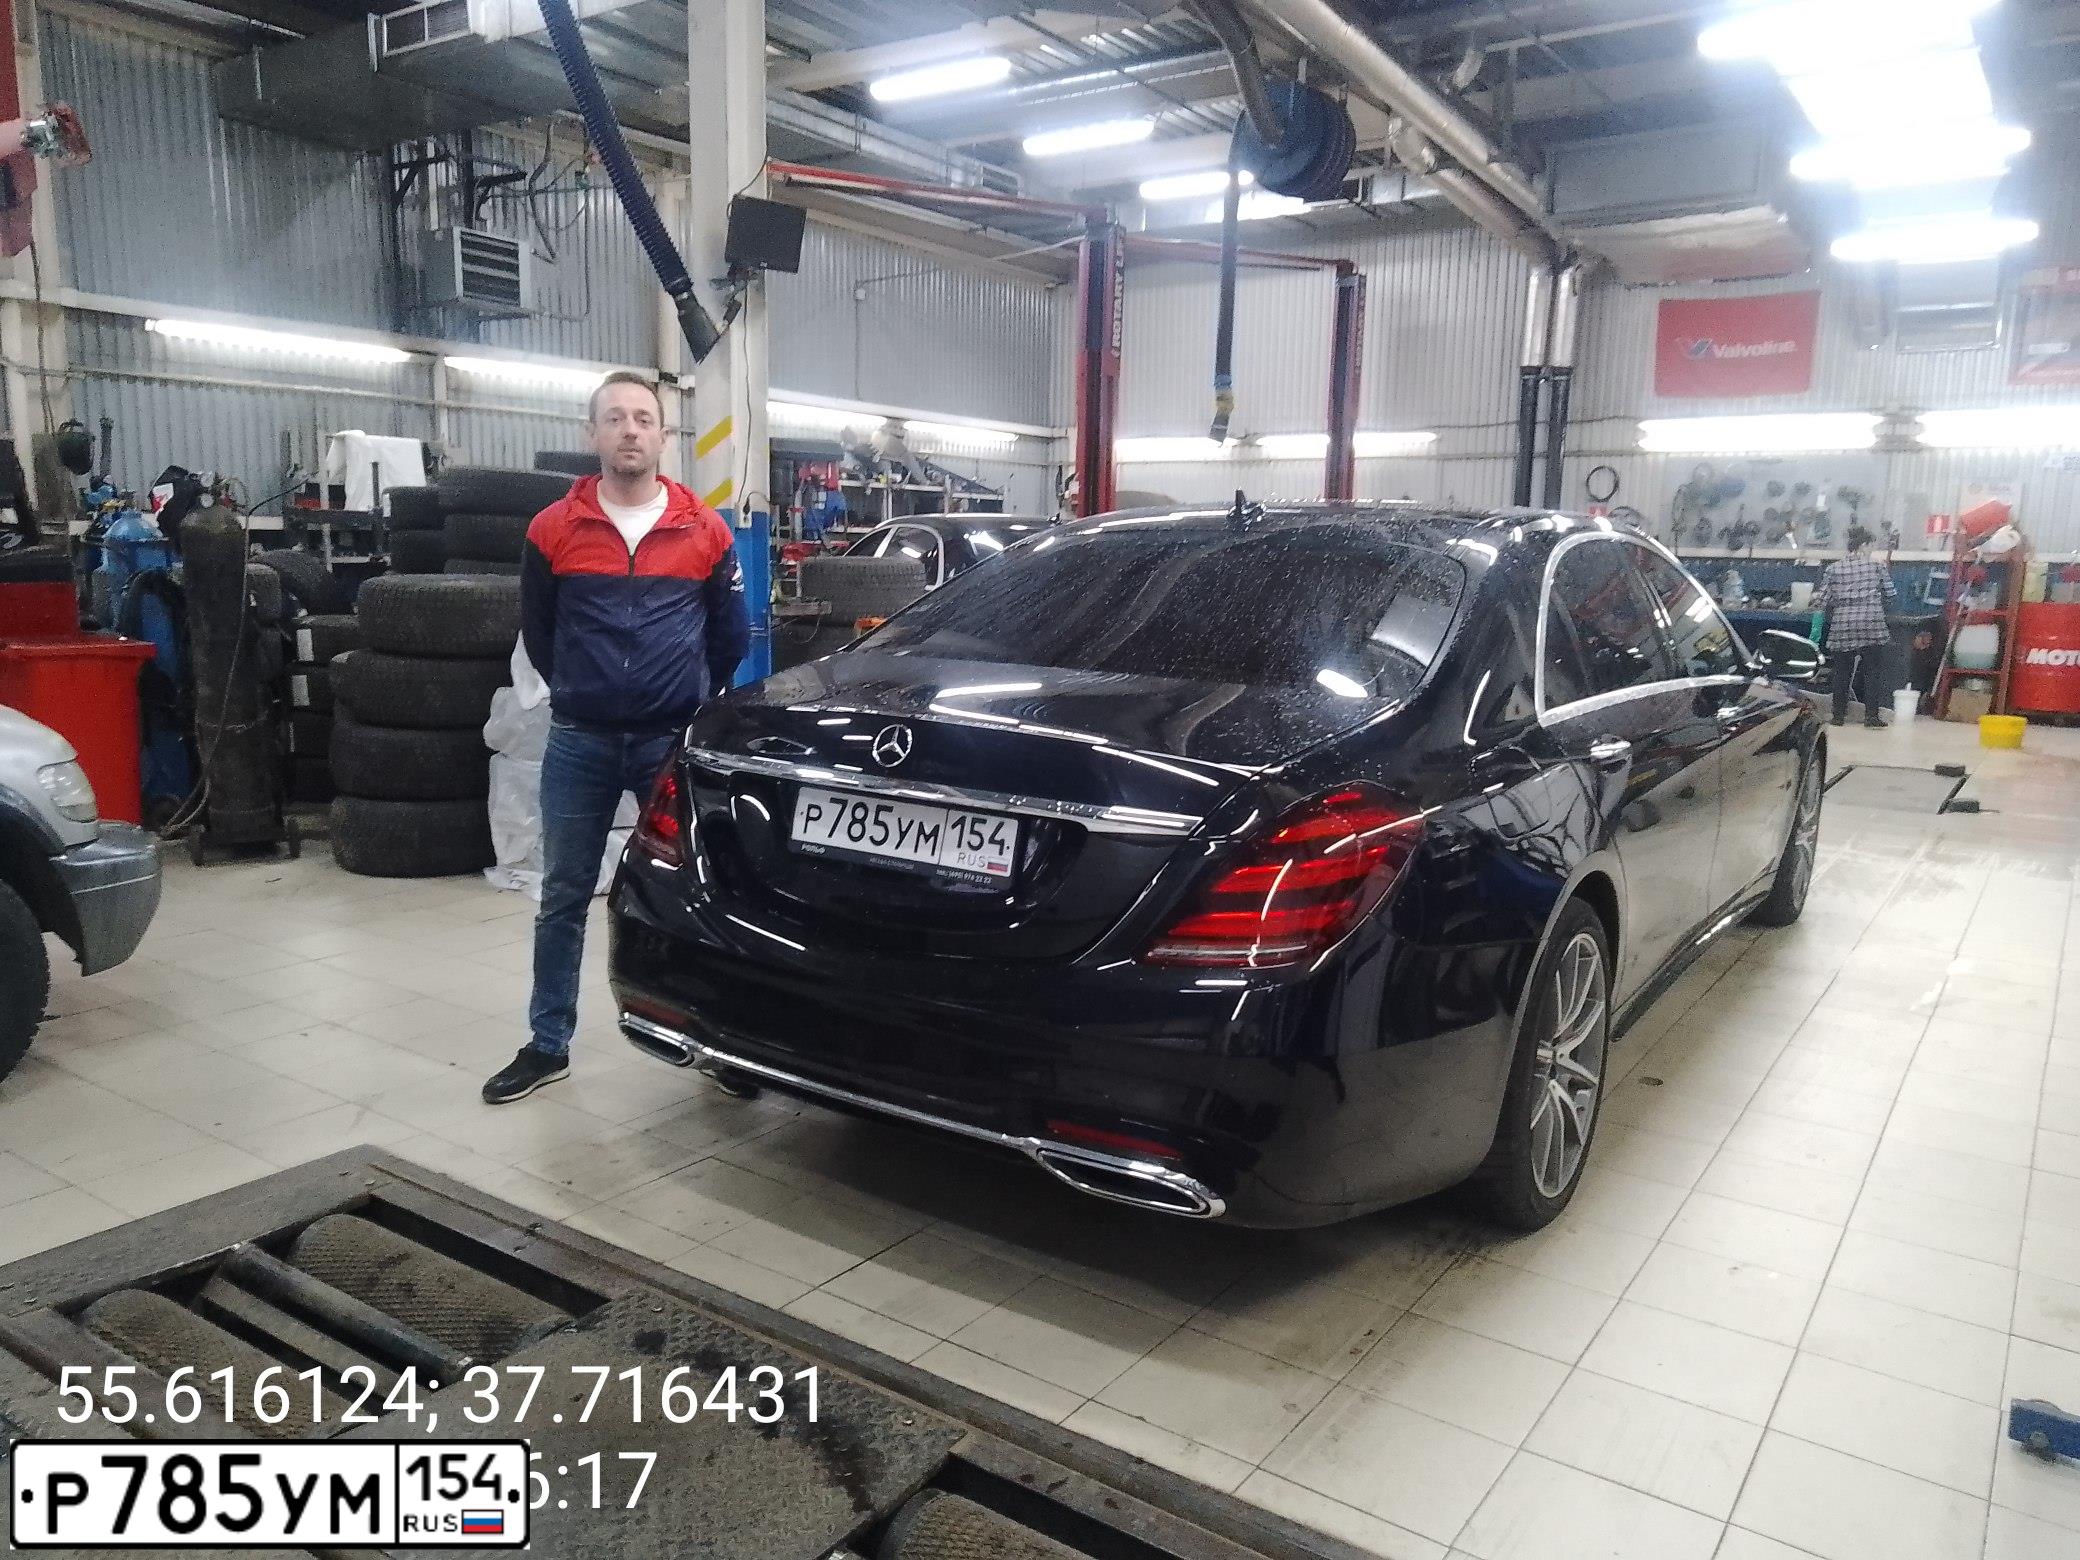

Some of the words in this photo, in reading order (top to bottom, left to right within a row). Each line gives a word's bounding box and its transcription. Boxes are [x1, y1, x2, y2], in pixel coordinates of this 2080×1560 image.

[804, 797, 941, 856] Р785УМ
[951, 815, 1006, 856] 154
[957, 852, 986, 868] RUS
